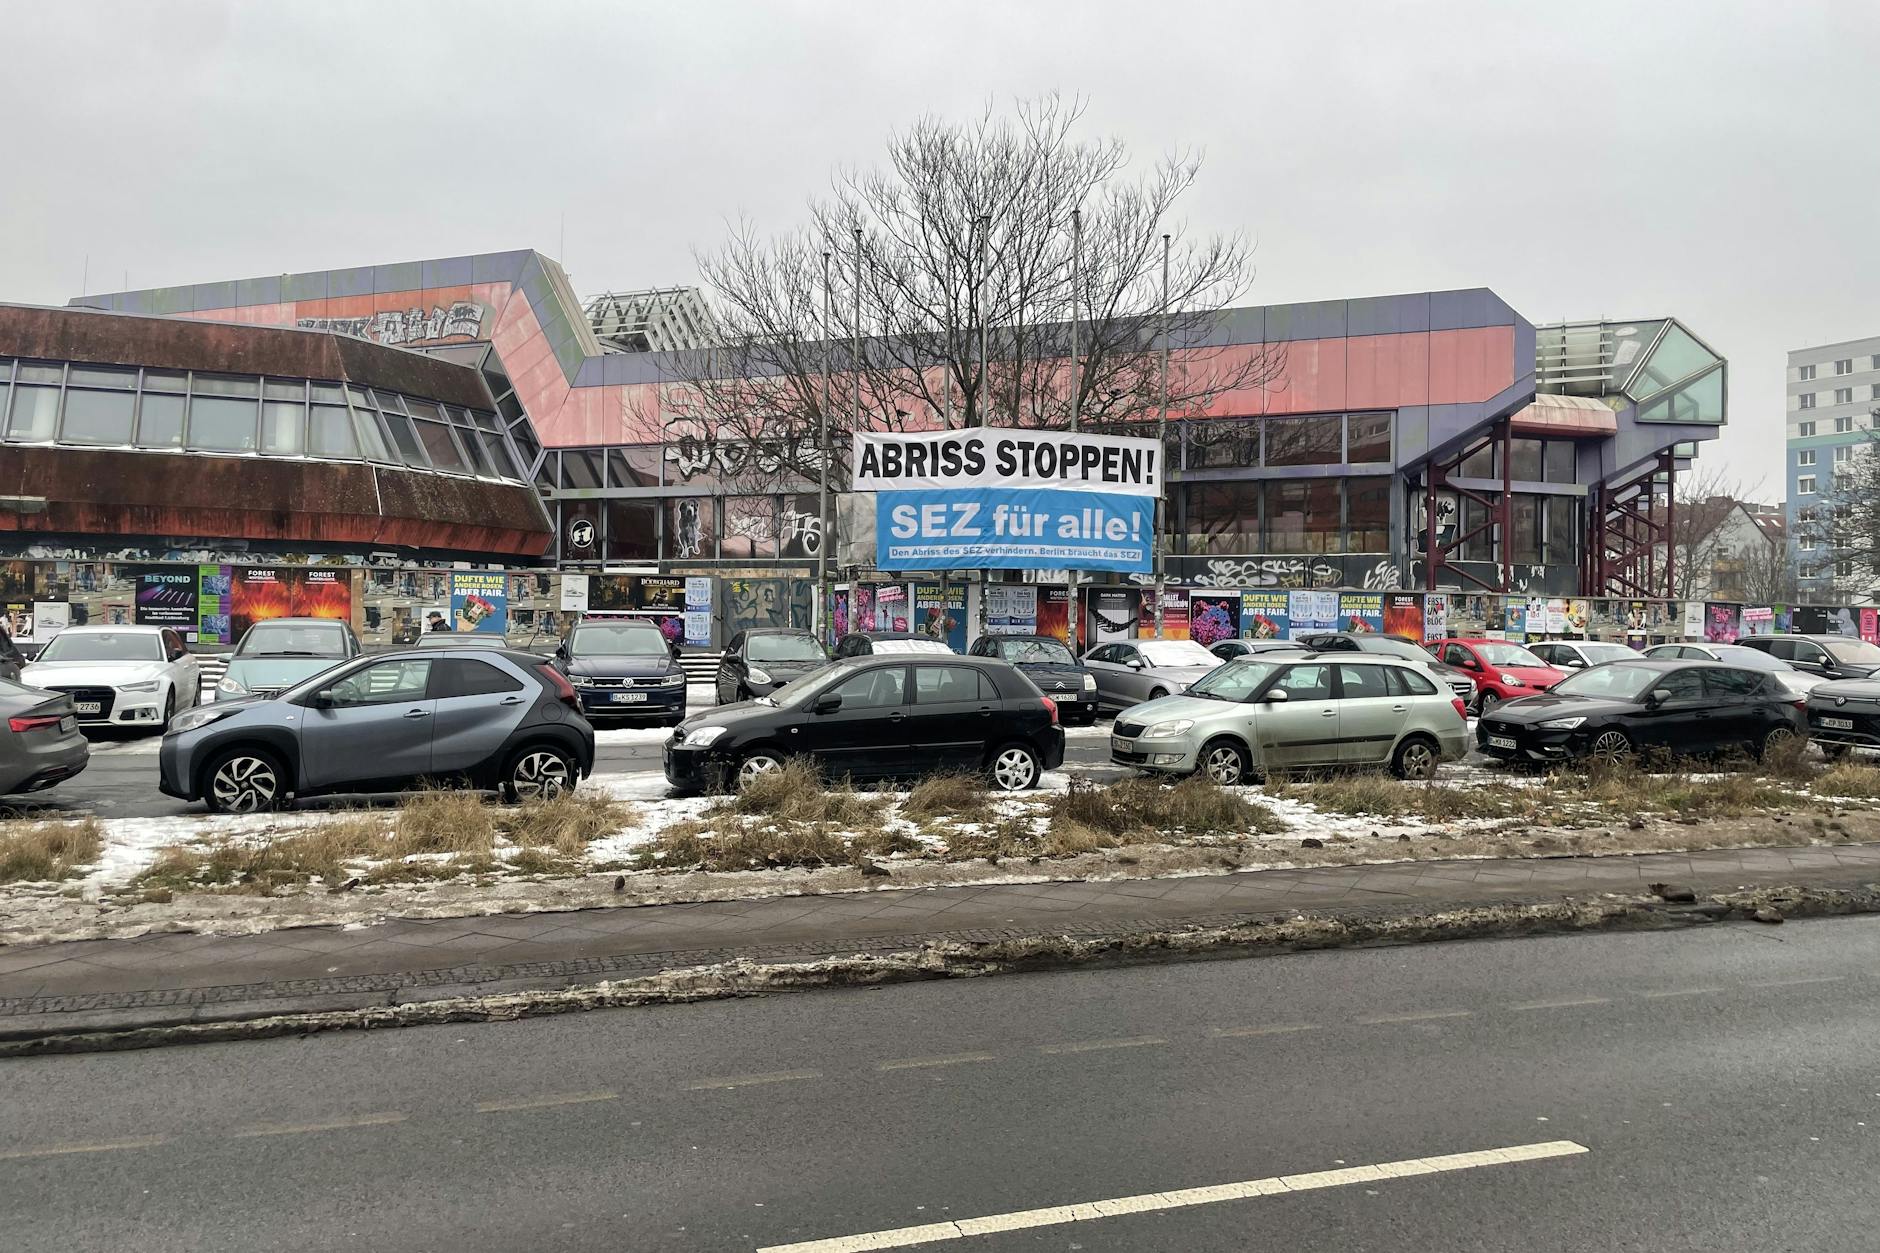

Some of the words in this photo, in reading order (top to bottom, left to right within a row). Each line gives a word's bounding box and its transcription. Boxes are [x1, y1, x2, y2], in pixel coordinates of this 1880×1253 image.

[859, 439, 986, 478] ABRISS
[995, 439, 1155, 485] STOPPEN!
[891, 503, 981, 539] SEZ
[993, 504, 1050, 537] für
[1057, 508, 1141, 542] alle!
[891, 549, 909, 557] Den
[912, 548, 940, 557] Abriss
[943, 547, 960, 555] des
[963, 546, 982, 555] SEZ
[985, 546, 1037, 555] verhindern.
[1040, 547, 1065, 556] Berlin
[1068, 548, 1102, 558] braucht
[1103, 549, 1118, 558] das
[1120, 551, 1141, 560] SEZ!
[144, 575, 191, 583] BEYOND
[454, 574, 485, 583] DUFTE
[486, 575, 505, 584] WIE
[453, 588, 480, 597] ABER
[481, 589, 505, 597] FAIR.
[1242, 593, 1270, 602] DUFTE
[1271, 594, 1288, 602] WIE
[1367, 596, 1382, 604] WIE
[1427, 597, 1443, 606] EAST
[1242, 607, 1266, 616] ABER
[1267, 608, 1288, 616] FAIR.
[1340, 609, 1361, 617] ABER
[1363, 609, 1382, 617] FAIR.
[1427, 617, 1443, 626] BLOC
[1427, 633, 1442, 641] EAST
[80, 703, 100, 711] 2736
